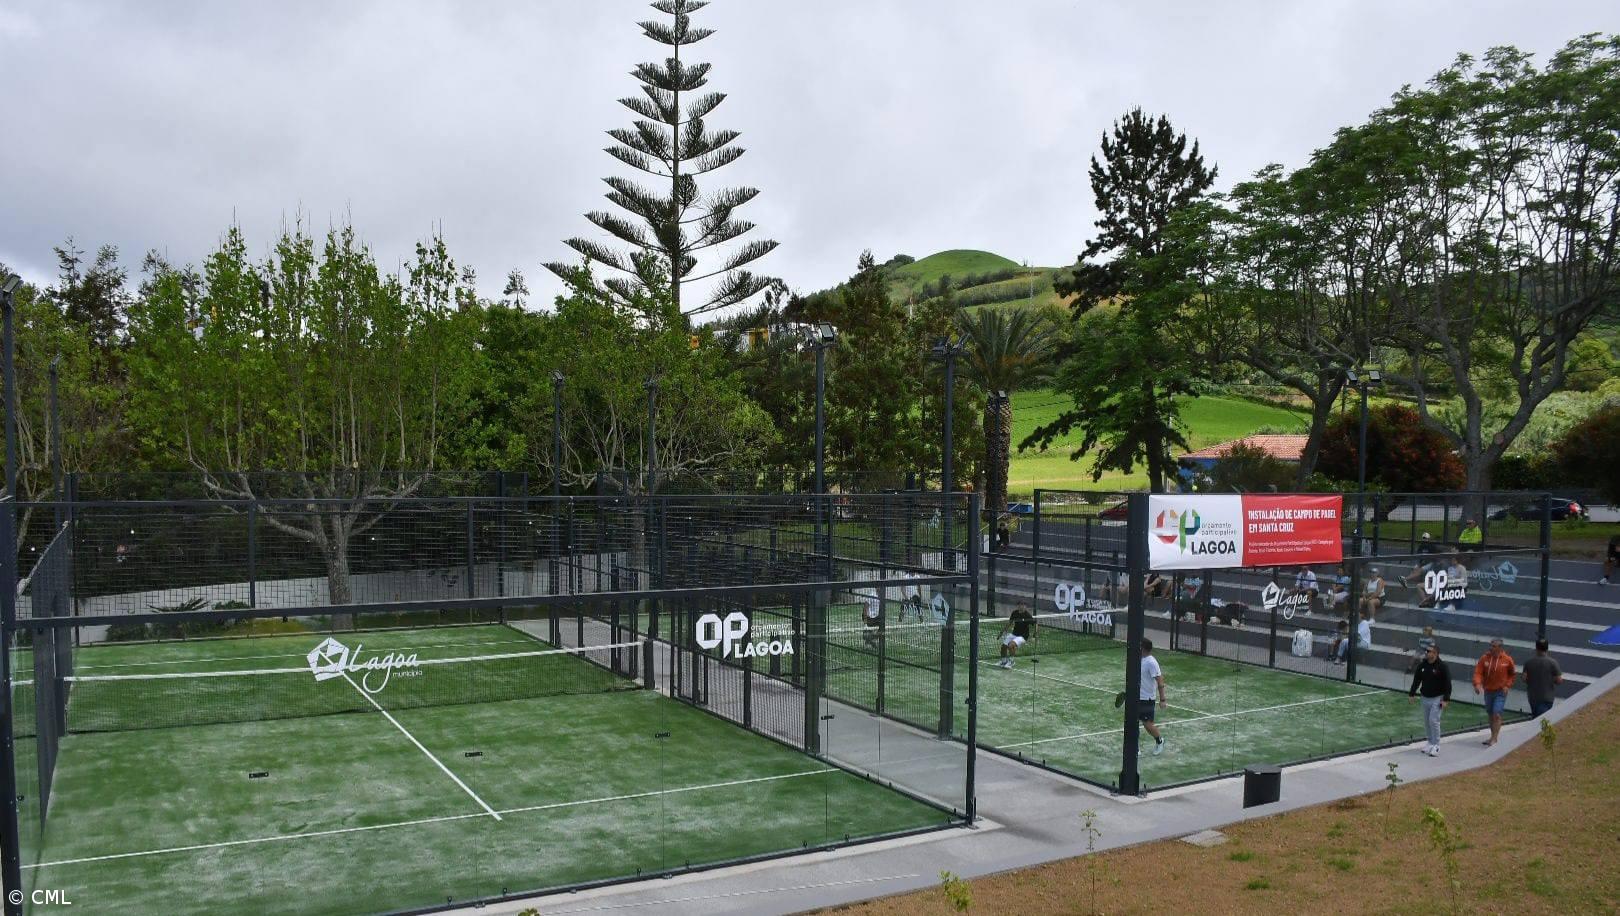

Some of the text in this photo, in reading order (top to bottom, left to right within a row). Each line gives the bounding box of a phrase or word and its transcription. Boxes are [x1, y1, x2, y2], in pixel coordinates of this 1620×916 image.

[1248, 508, 1284, 521] INSTALAÇÃO
[1285, 510, 1293, 519] DE
[1293, 509, 1313, 519] CAMPO
[1313, 509, 1320, 519] DE
[1249, 522, 1294, 533] EM SANTA CRUZ
[1191, 540, 1237, 555] LAGOA
[1424, 570, 1448, 602] OP
[1440, 588, 1466, 601] LAGOA
[1055, 584, 1085, 620] OP
[1279, 587, 1309, 619] Lagoa
[1075, 610, 1112, 626] LAGOA
[695, 611, 749, 659] OP
[734, 640, 794, 659] LAGOA
[349, 644, 420, 693] Lagoa
